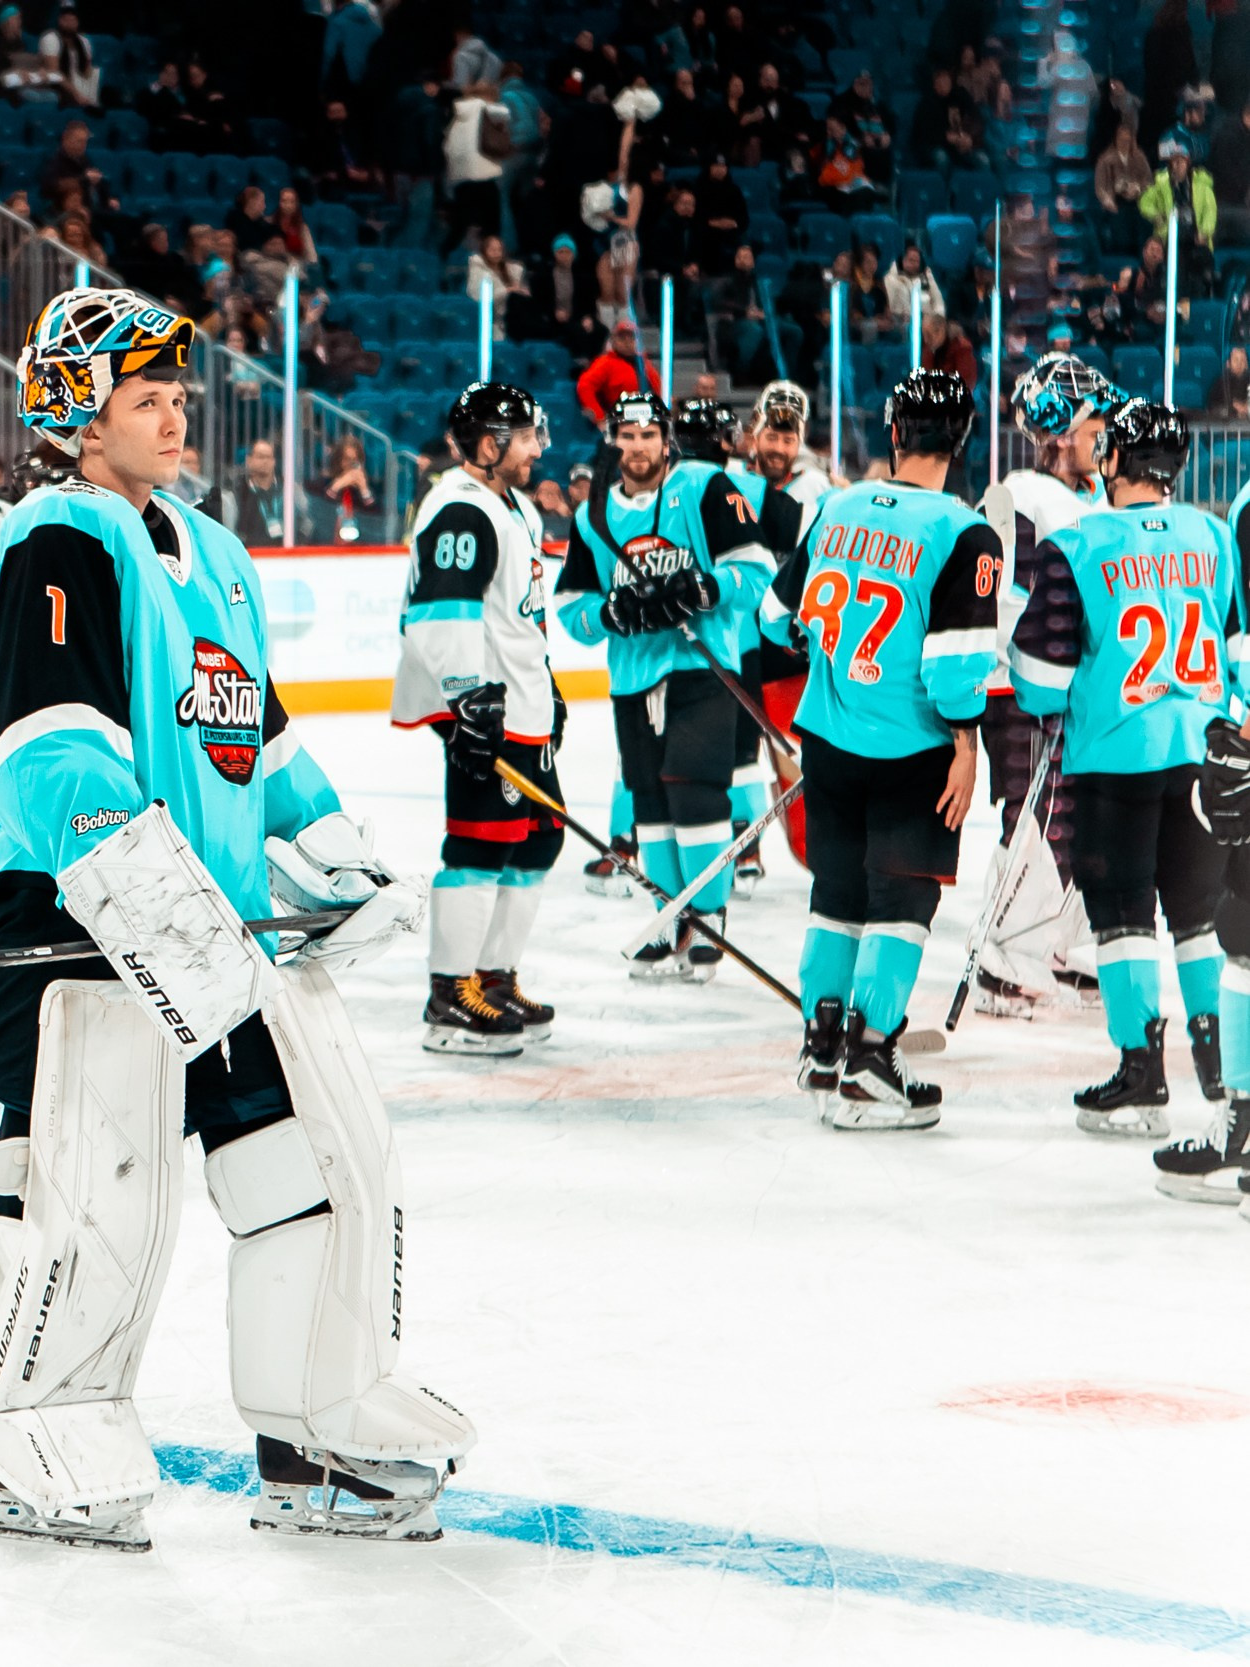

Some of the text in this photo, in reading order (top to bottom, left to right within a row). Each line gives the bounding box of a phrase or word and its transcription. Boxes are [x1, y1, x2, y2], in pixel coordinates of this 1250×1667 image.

[434, 531, 477, 571] 89
[815, 524, 924, 580] GOLDOBIN
[46, 585, 67, 645] 1
[799, 569, 905, 686] 87
[1117, 600, 1223, 706] 24
[71, 809, 129, 836] Bobrov
[121, 951, 199, 1045] BAUER
[22, 1258, 62, 1382] BAUER
[391, 1205, 404, 1341] BAUER
